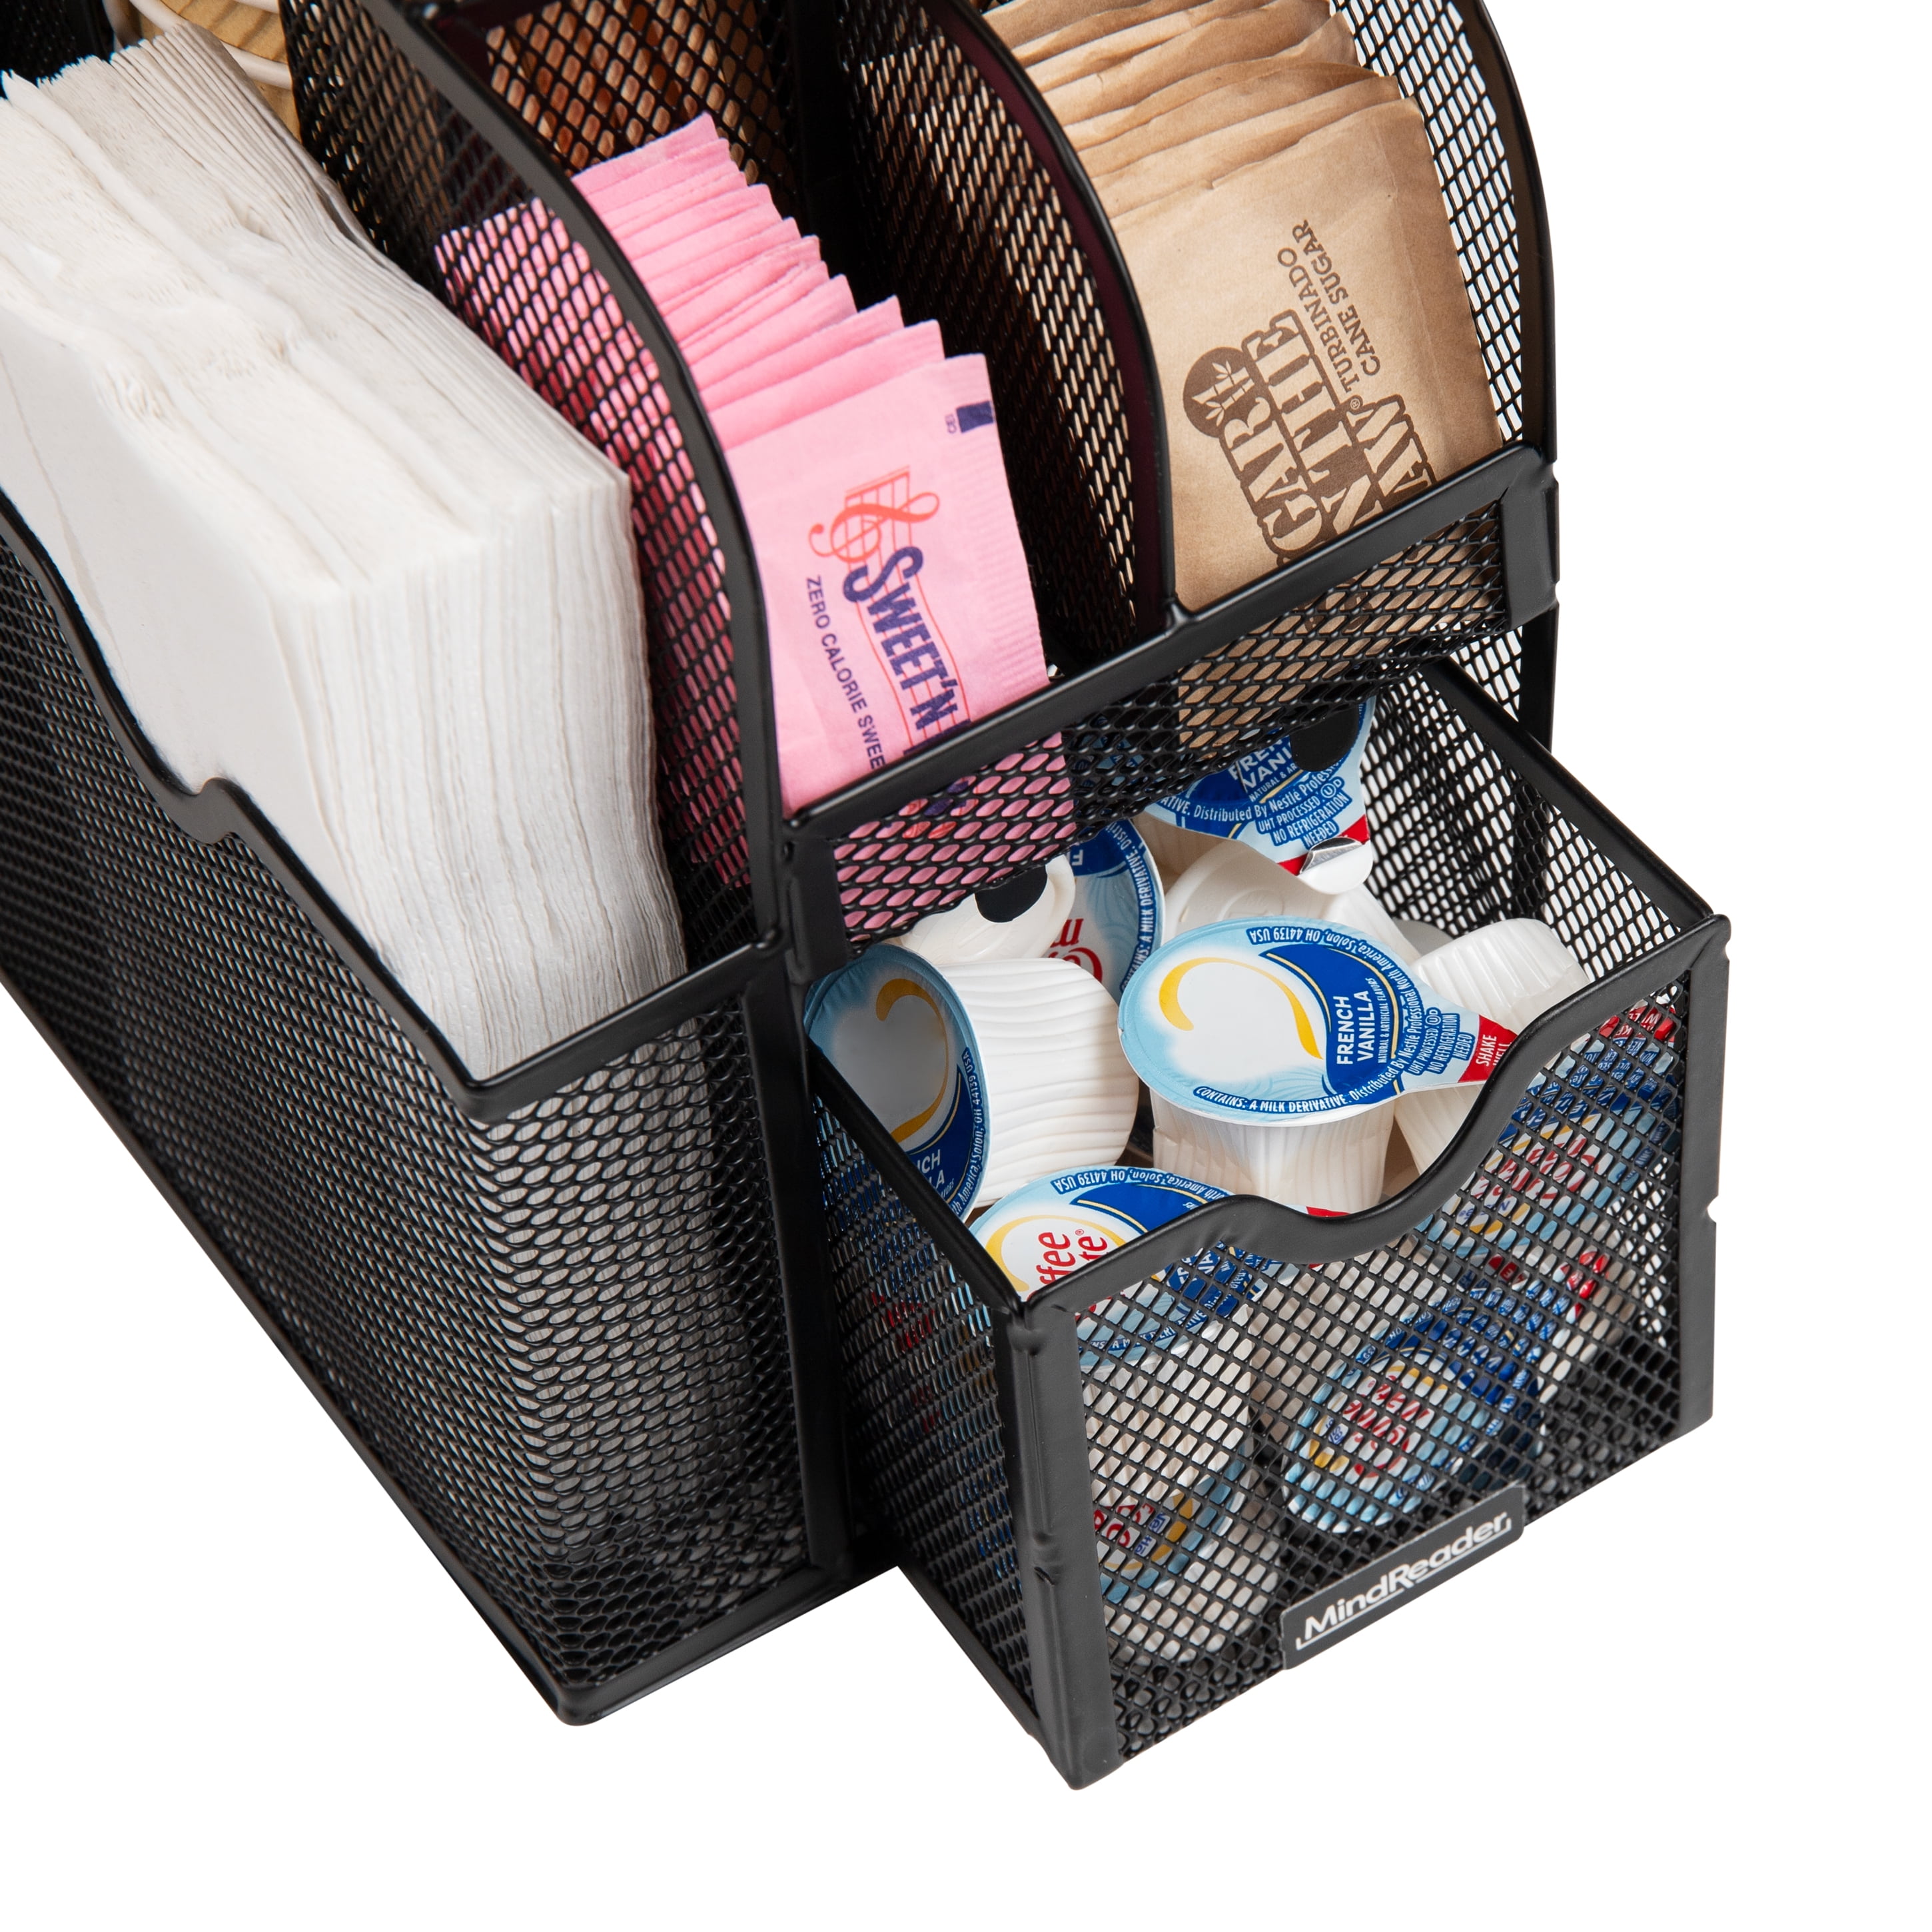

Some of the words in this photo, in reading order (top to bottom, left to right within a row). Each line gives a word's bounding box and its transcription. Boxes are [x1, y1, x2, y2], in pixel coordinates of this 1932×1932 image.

[1292, 219, 1349, 304] SUGAR
[1277, 247, 1360, 393] TURBINADO
[1337, 304, 1381, 376] CANE
[1246, 316, 1352, 483] THE
[1224, 396, 1323, 554] GAR
[806, 575, 830, 629] ZERO
[821, 634, 867, 713] CALORIE
[858, 715, 886, 769] SWEE
[1243, 741, 1292, 789] VANI
[1248, 777, 1280, 802] NATURAL
[1193, 805, 1251, 821] Distributed
[1254, 805, 1267, 818] By
[1269, 788, 1300, 813] Nestlé
[1258, 817, 1275, 832] UHT
[1273, 831, 1286, 845] NO
[1288, 792, 1350, 839] REFRIGERATION
[1302, 820, 1337, 847] NEEDED
[1141, 908, 1154, 933] MILK
[1250, 929, 1270, 943] USA
[1273, 927, 1303, 941] 44139
[1305, 929, 1320, 941] OH
[1365, 977, 1386, 1001] FLAVORS
[1389, 969, 1412, 991] North
[1379, 1002, 1390, 1032] ARTIFICIAL
[1405, 989, 1422, 1033] Professional
[1334, 996, 1354, 1065] FRENCH
[1354, 991, 1375, 1061] VANILLA
[1434, 1014, 1457, 1062] REFRIGERATION
[1378, 1039, 1389, 1063] NATURAL
[1404, 1034, 1420, 1059] Nestlé
[1452, 1033, 1473, 1059] NEEDED
[1476, 1034, 1497, 1067] SHAKE
[963, 1051, 973, 1073] USA
[1390, 1055, 1408, 1069] By
[1408, 1061, 1424, 1074] UHT
[1427, 1059, 1442, 1073] NO
[969, 1075, 979, 1105] 44139
[1349, 1066, 1398, 1101] Distributed
[1196, 1087, 1247, 1109] CONTAINS:
[1249, 1101, 1259, 1111] A
[1260, 1100, 1285, 1113] MILK
[1288, 1095, 1351, 1113] DERIVATIVE.
[973, 1109, 983, 1123] OH
[1054, 1176, 1076, 1191] USA
[1077, 1171, 1106, 1186] 44139
[1111, 1170, 1125, 1181] OH
[1304, 1512, 1508, 1640] MindReader
